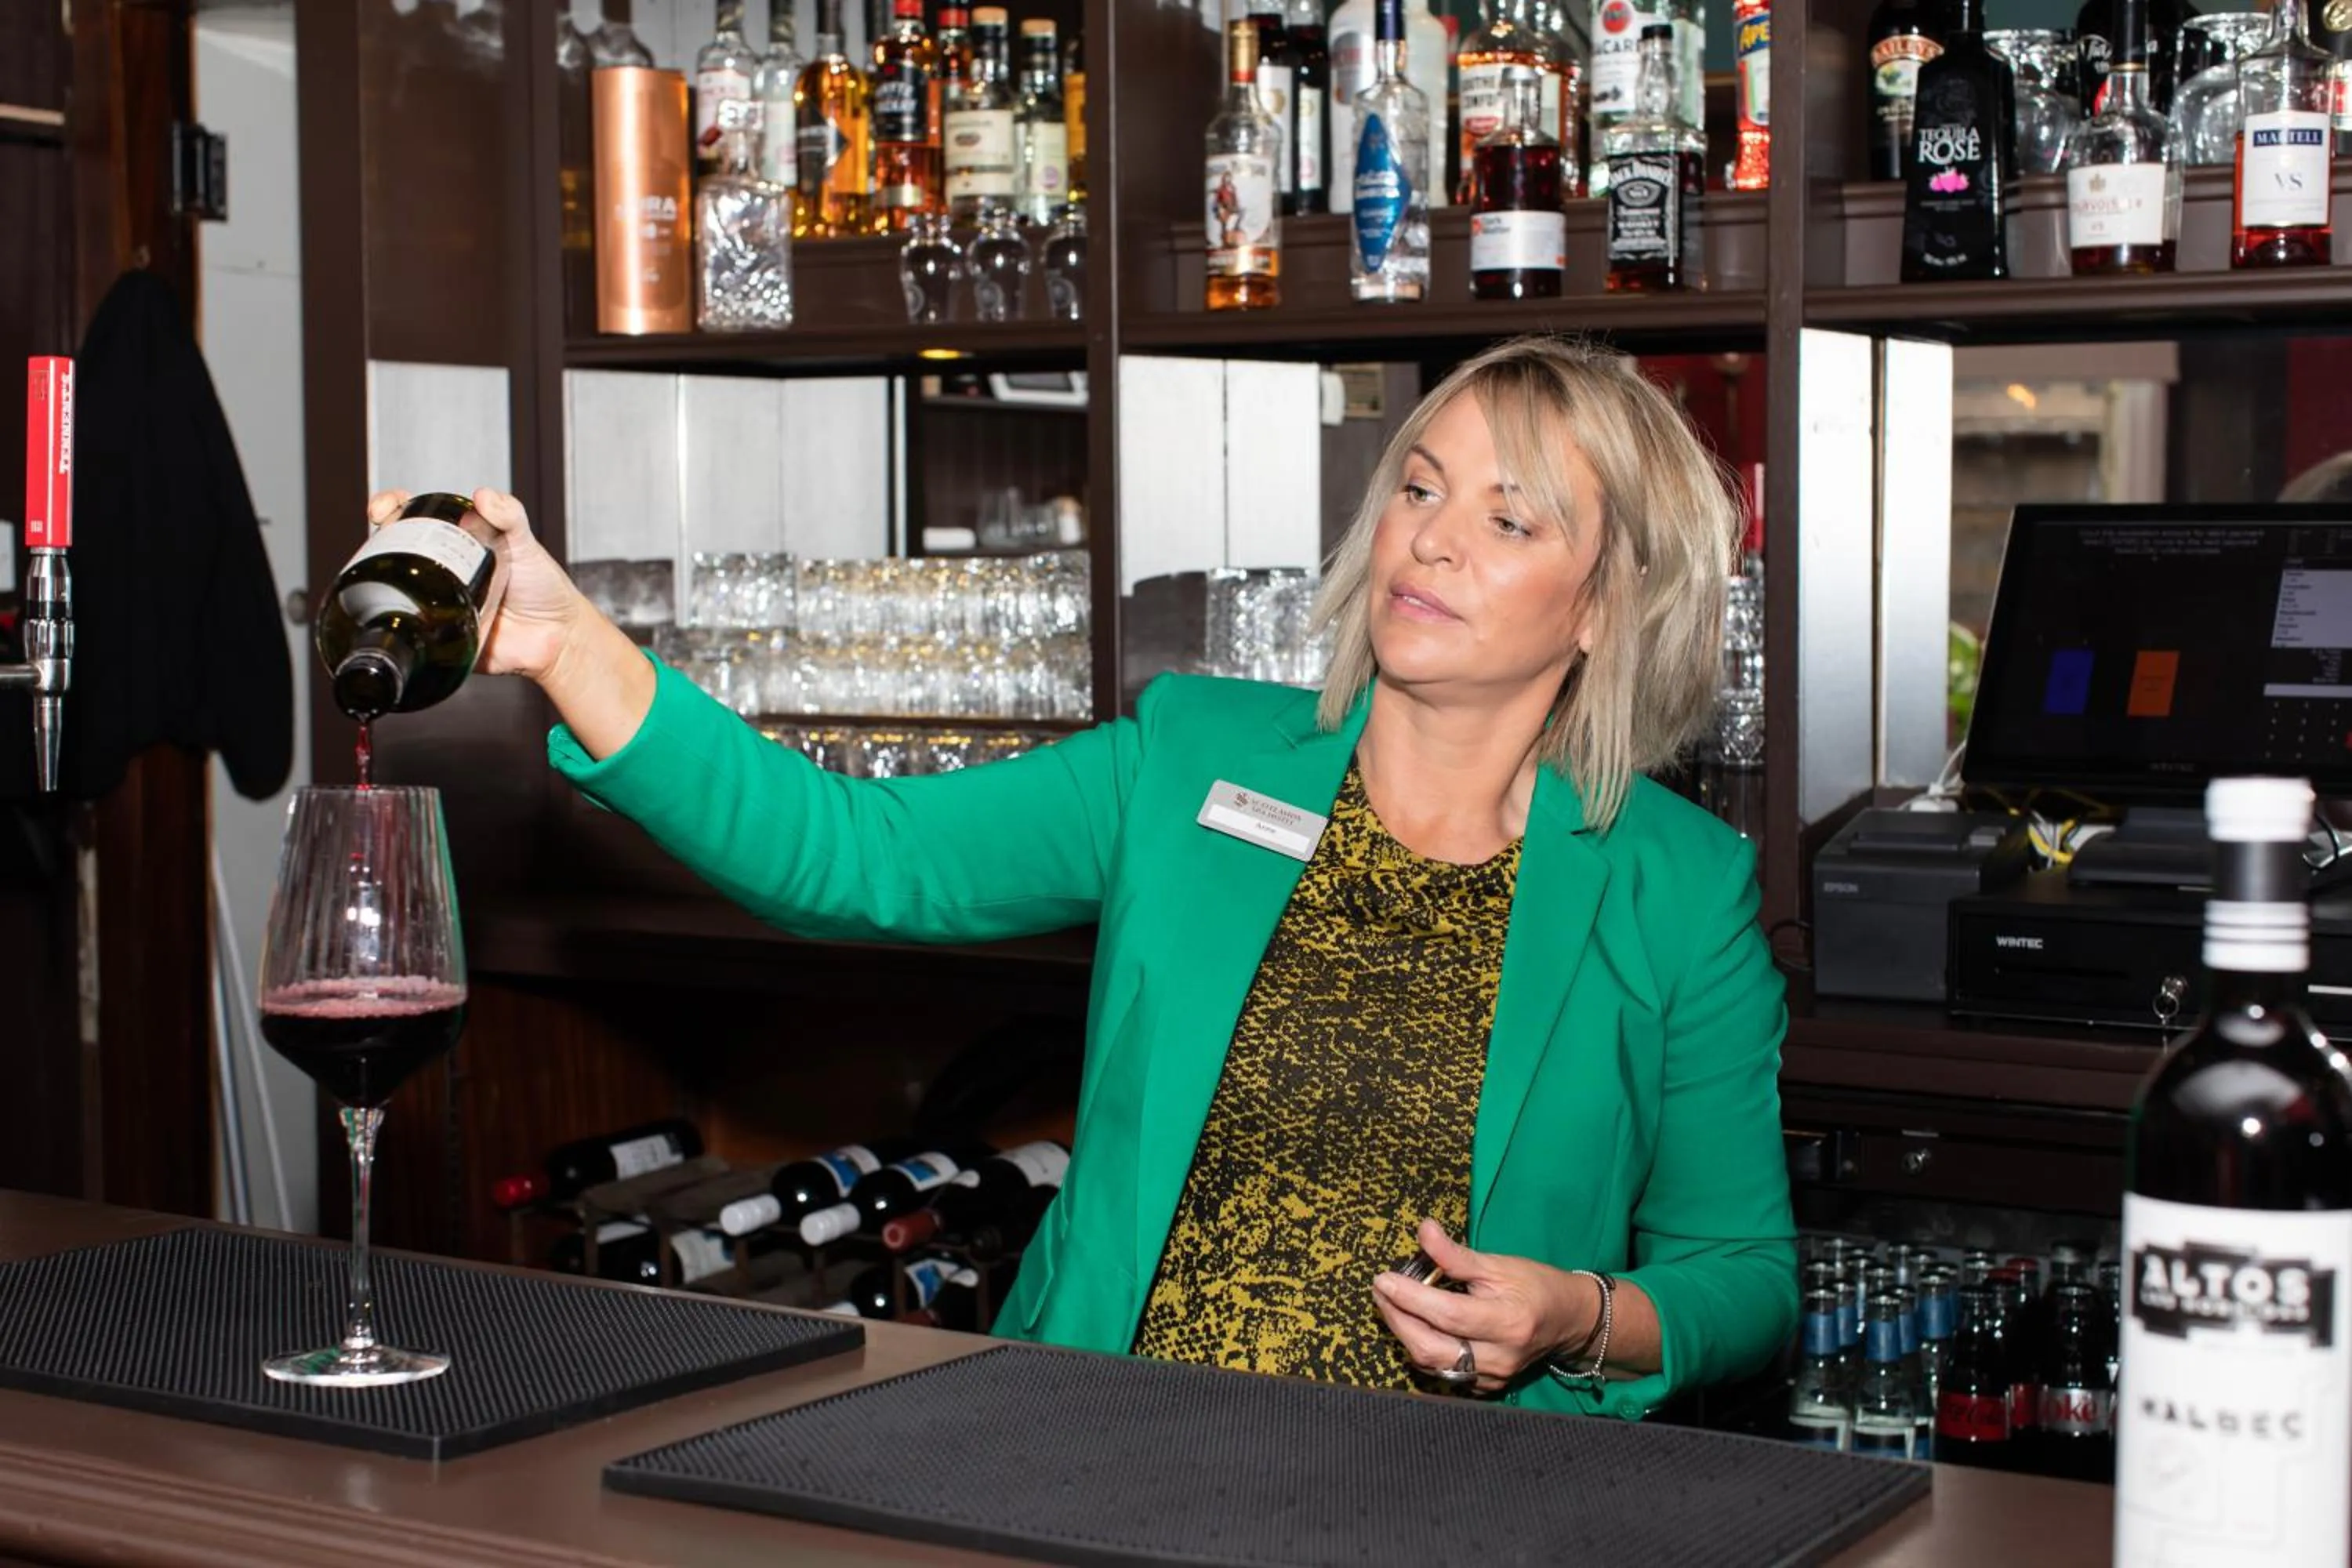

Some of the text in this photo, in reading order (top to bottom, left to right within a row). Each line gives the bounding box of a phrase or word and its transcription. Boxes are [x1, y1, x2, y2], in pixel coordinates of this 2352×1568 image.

[1918, 127, 1981, 144] TEQUILA
[2256, 129, 2320, 144] MATELL
[1918, 139, 1982, 165] ROSE
[2274, 172, 2303, 191] VS
[1823, 882, 1859, 894] EPSON
[1996, 935, 2044, 949] WINTEC
[2141, 1254, 2310, 1306] ALTOS
